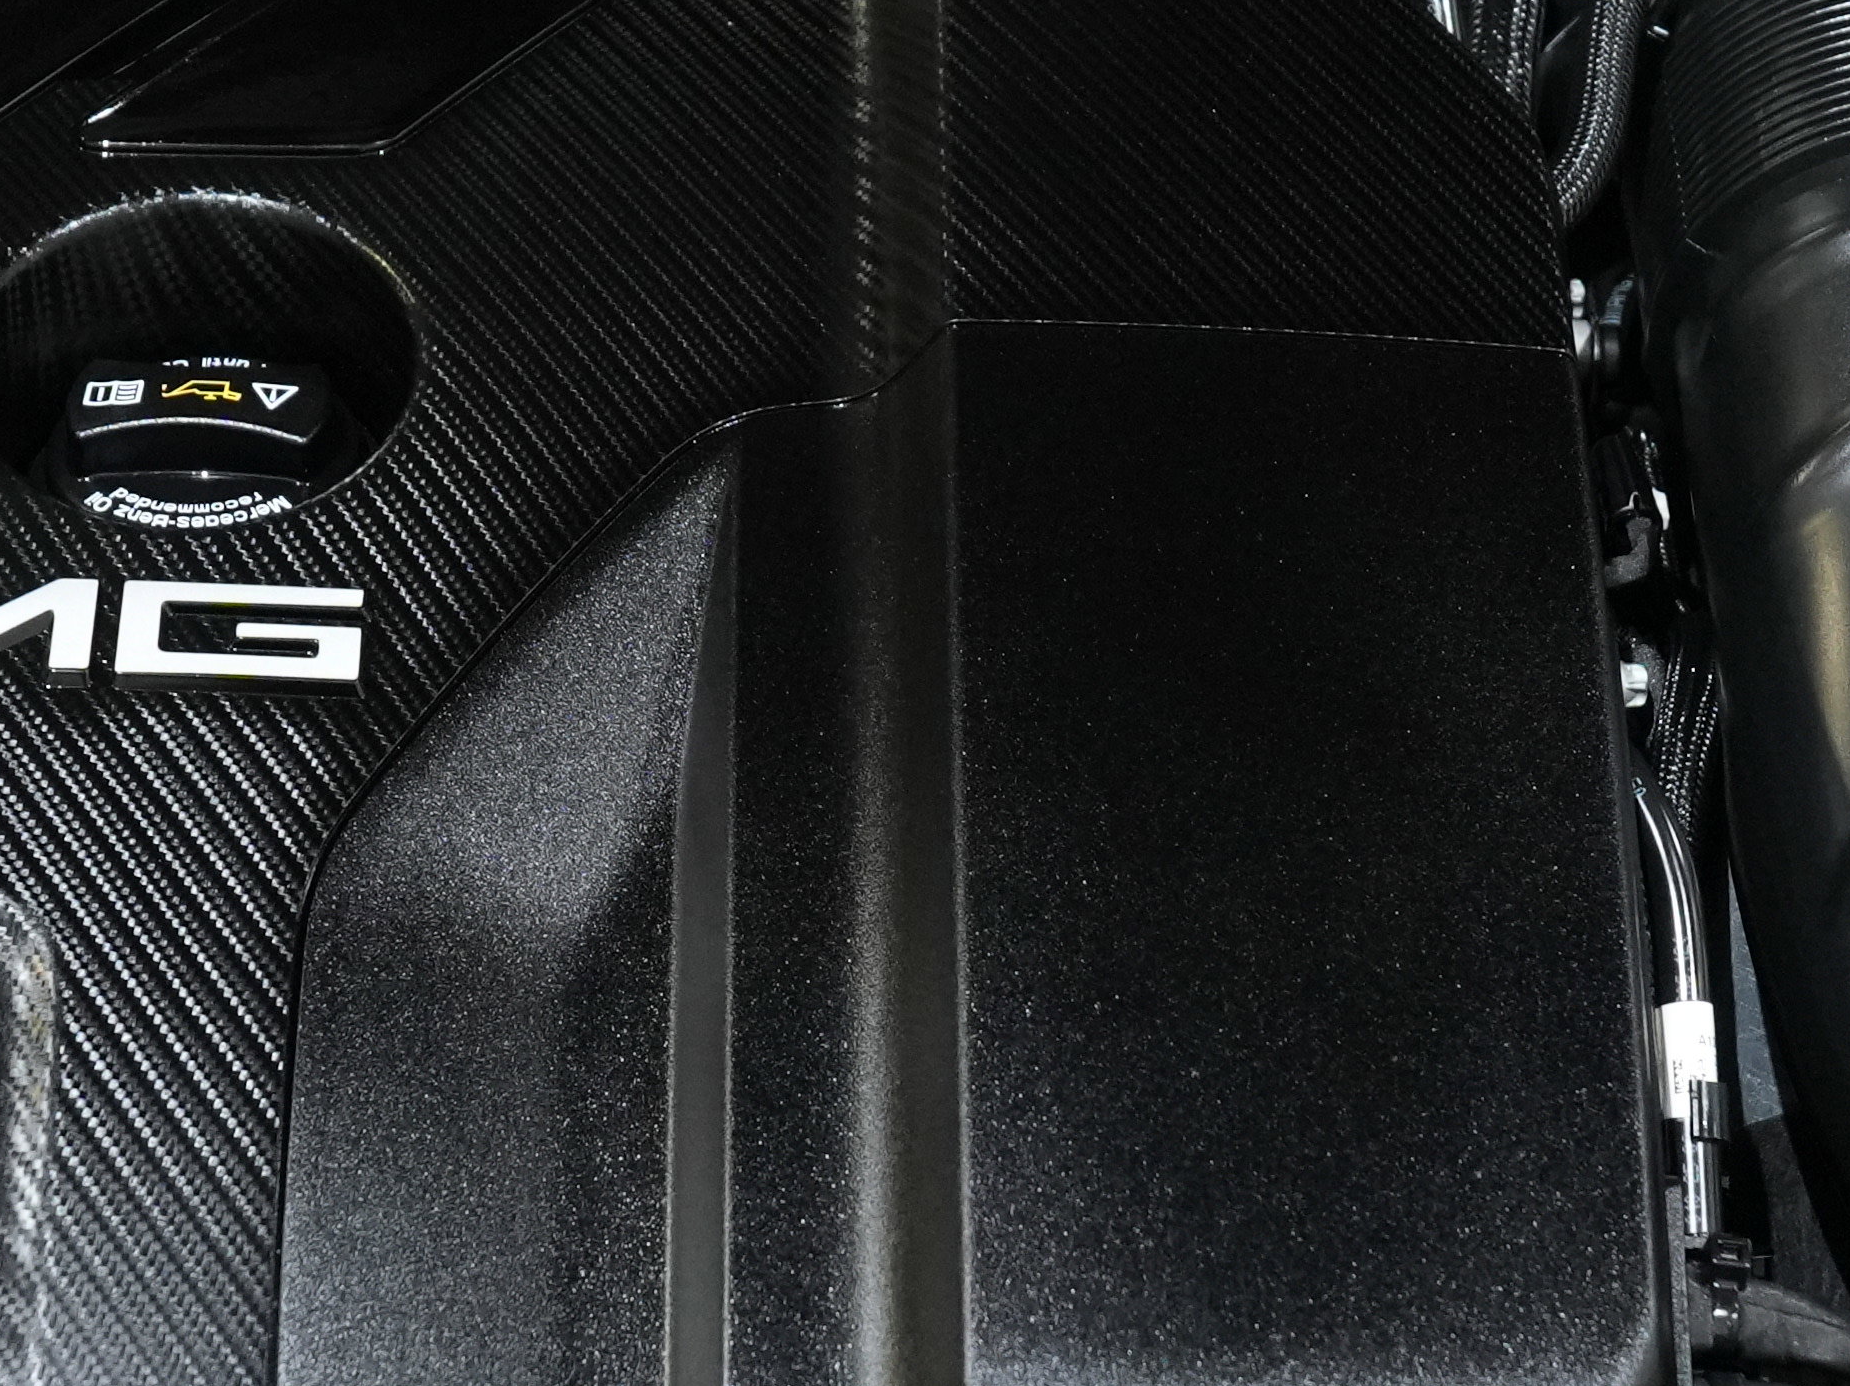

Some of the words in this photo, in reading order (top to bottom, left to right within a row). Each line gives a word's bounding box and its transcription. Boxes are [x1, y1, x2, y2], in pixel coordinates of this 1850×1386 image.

[83, 490, 113, 513] Oil
[109, 486, 264, 515] recommended
[113, 494, 294, 530] Mercedes-Benz
